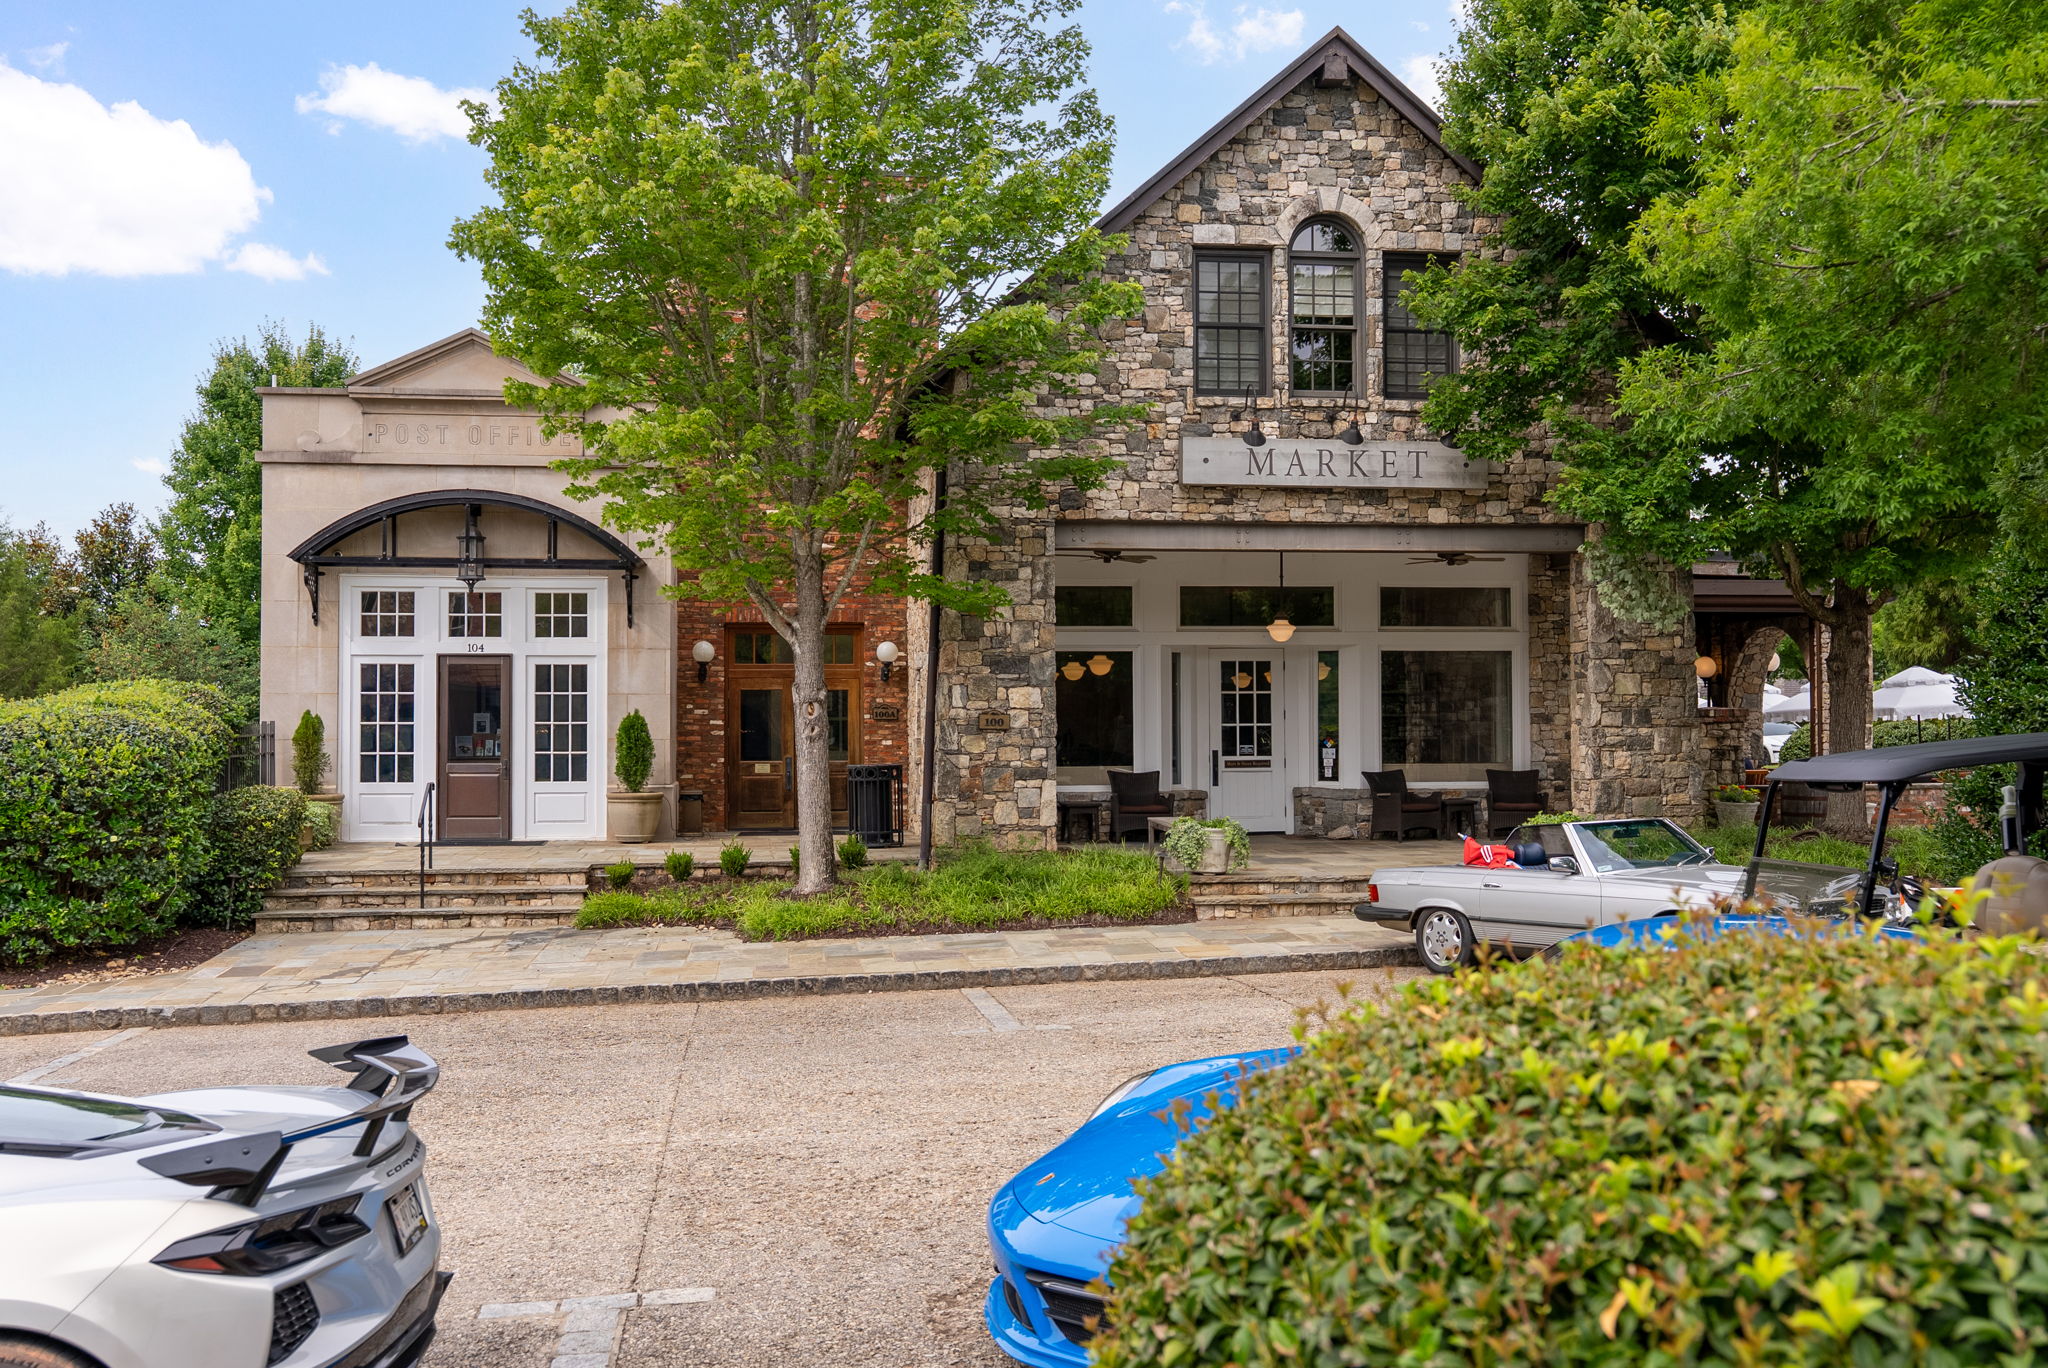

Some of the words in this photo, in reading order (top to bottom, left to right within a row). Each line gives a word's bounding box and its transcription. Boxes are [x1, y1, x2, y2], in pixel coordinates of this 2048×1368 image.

[374, 423, 449, 445] POST
[1245, 447, 1429, 479] MARKET
[467, 643, 485, 653] 104
[984, 718, 1004, 727] 100
